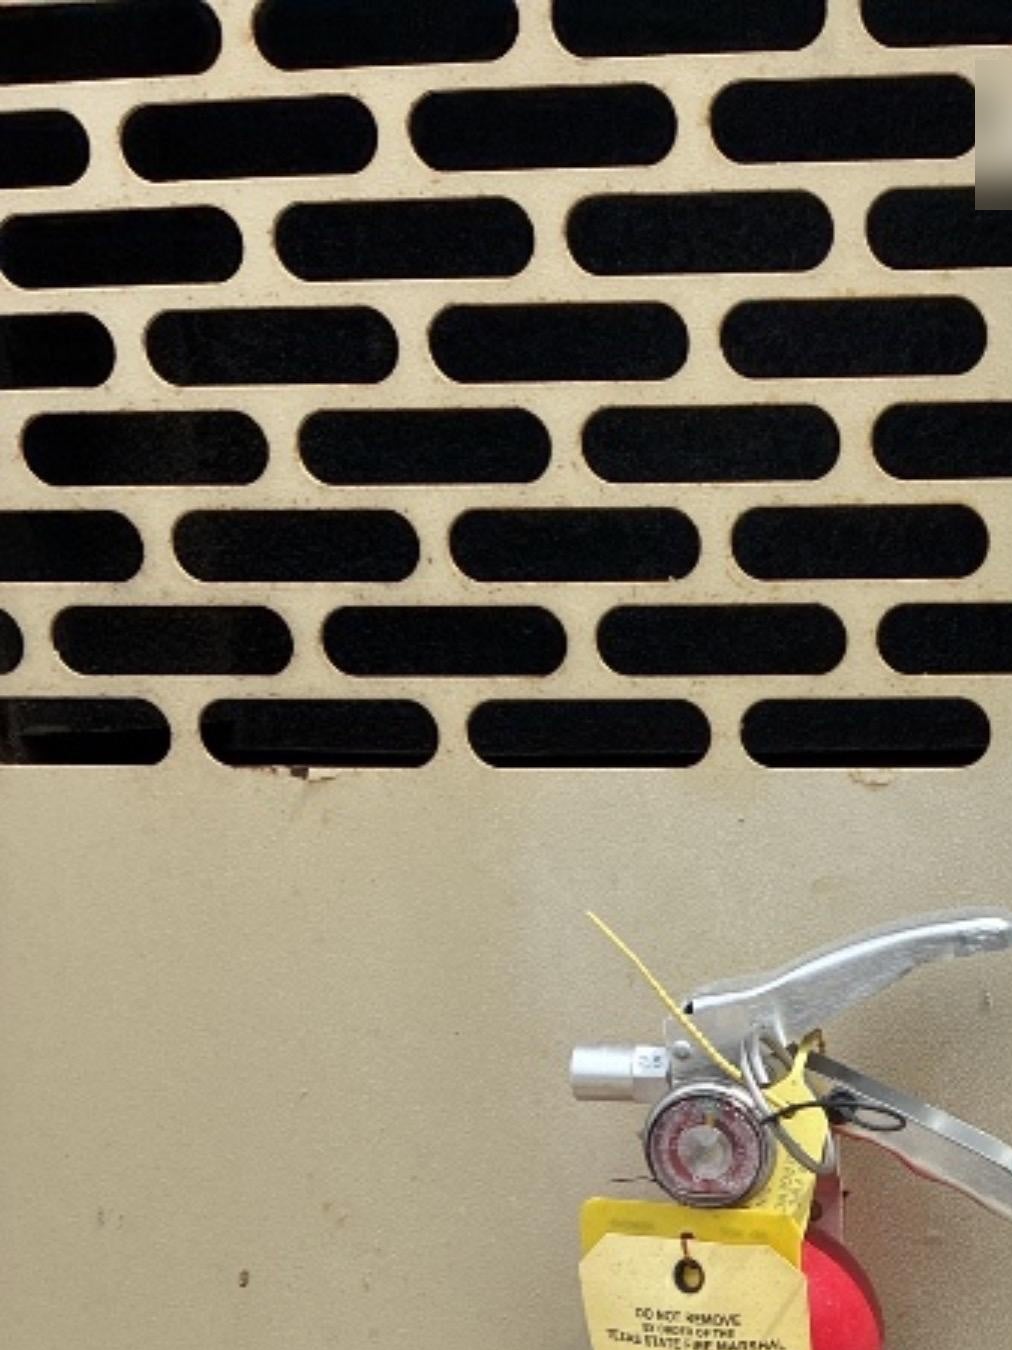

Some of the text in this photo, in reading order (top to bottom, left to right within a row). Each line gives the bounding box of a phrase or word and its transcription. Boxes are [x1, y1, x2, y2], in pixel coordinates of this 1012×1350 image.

[635, 1307, 741, 1326] DO NOT REMOVE
[645, 1331, 681, 1348] STATE
